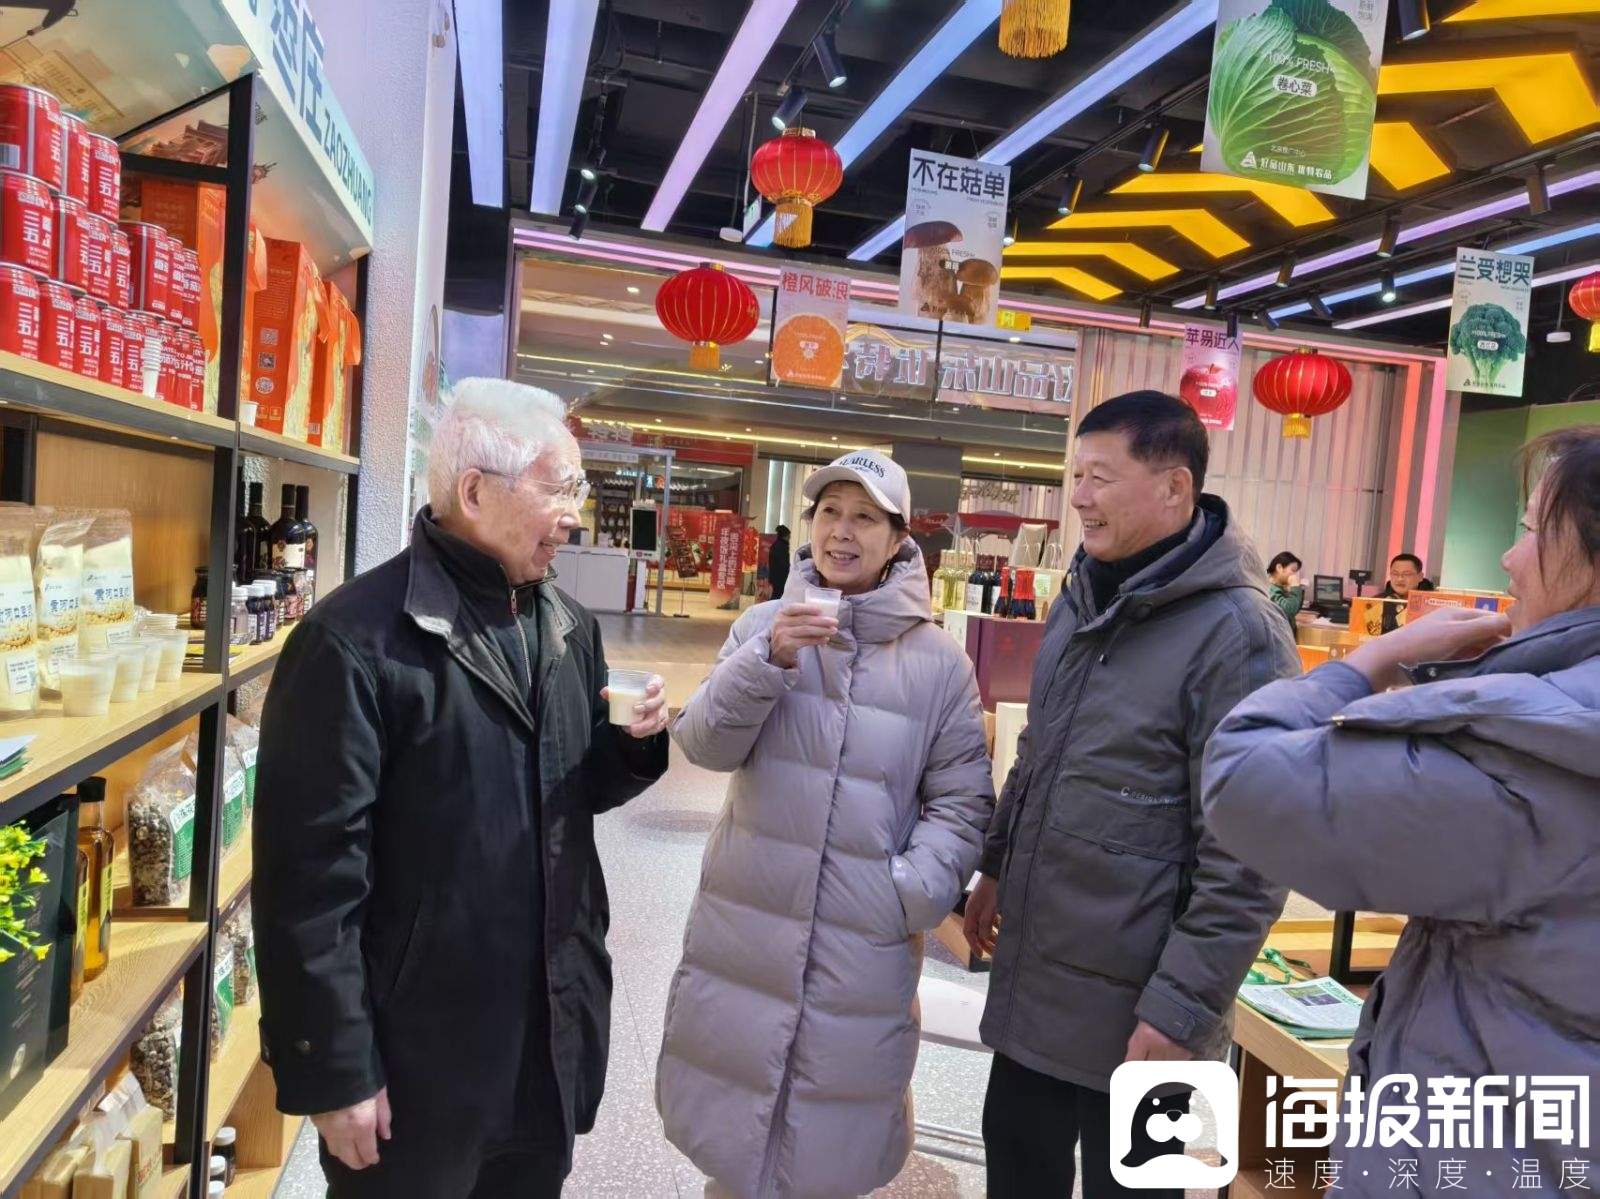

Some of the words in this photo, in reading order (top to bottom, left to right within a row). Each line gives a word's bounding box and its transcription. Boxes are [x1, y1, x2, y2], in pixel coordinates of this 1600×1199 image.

[1277, 76, 1312, 96] 卷心菜
[322, 108, 372, 226] ZAOZHUANG
[912, 156, 1006, 199] 不在菇单
[1458, 255, 1531, 286] 兰受想哭
[782, 272, 848, 301] 橙风破浪
[1185, 327, 1240, 352] 苹易近人
